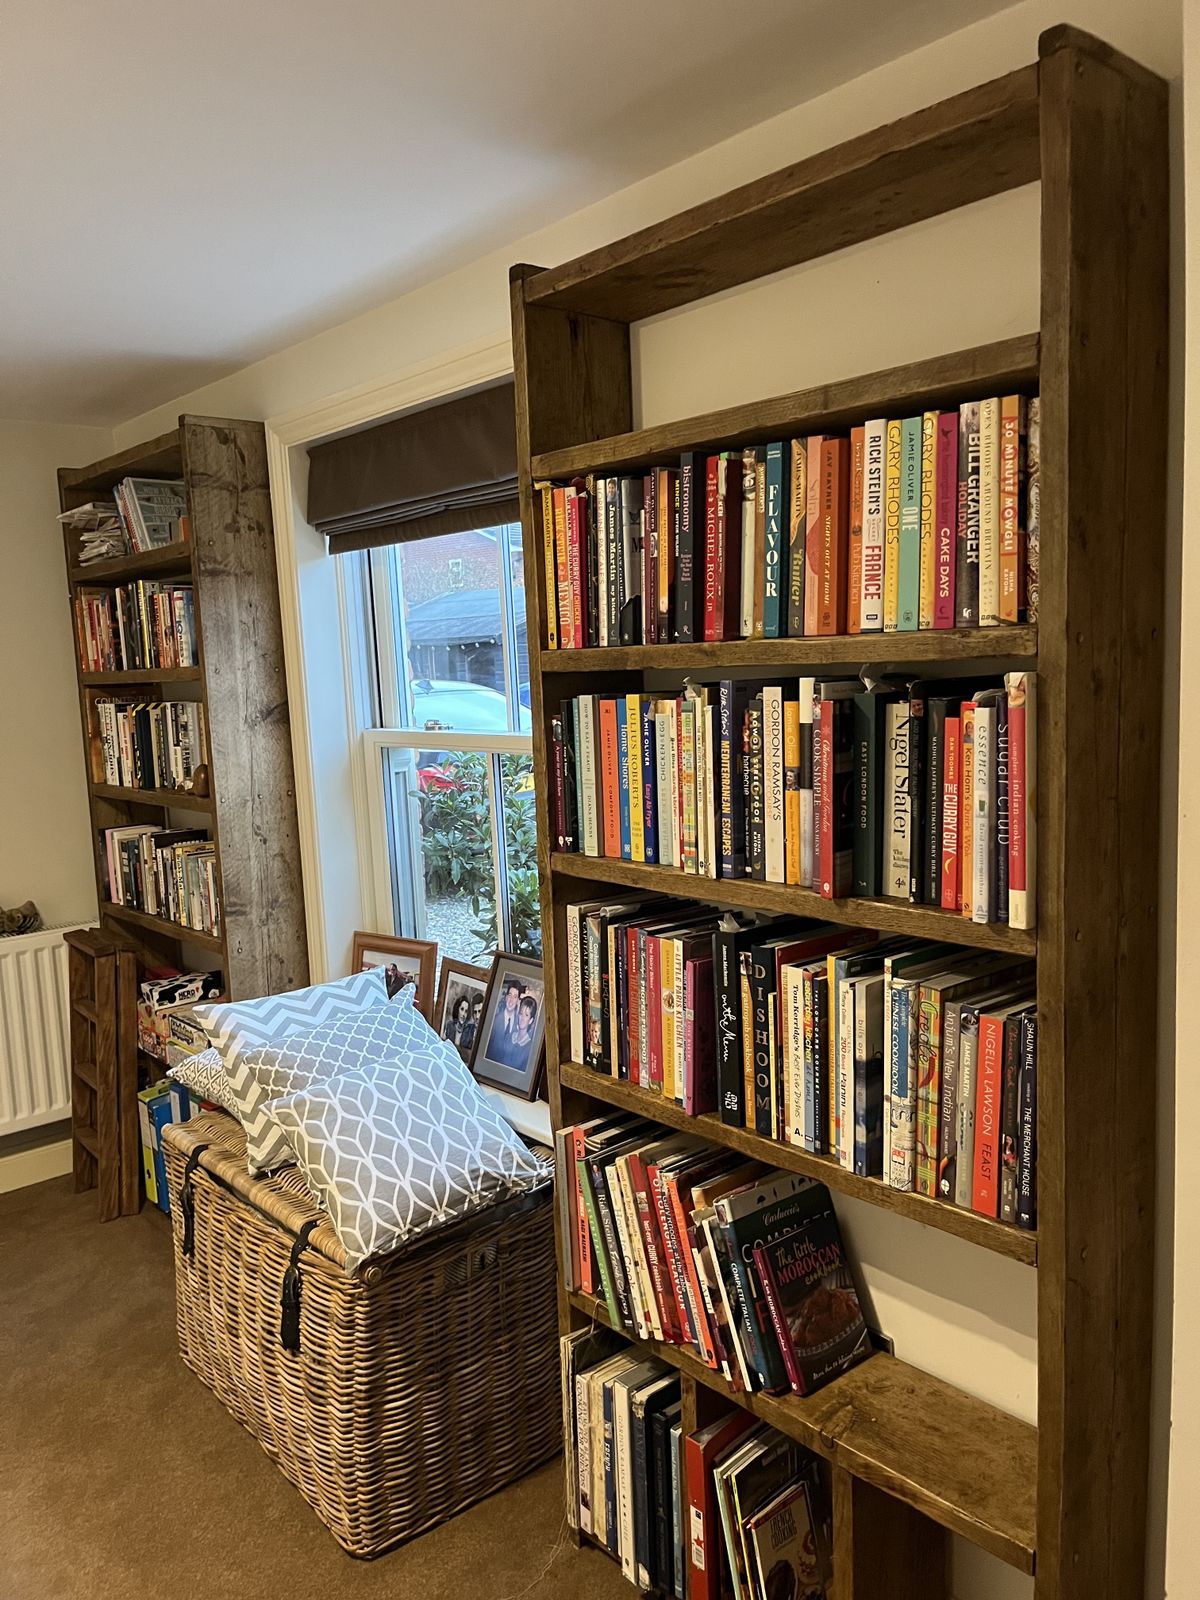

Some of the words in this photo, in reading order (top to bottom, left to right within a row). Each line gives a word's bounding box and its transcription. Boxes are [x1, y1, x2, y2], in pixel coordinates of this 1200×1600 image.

[984, 402, 992, 430] OPEN
[1005, 421, 1014, 438] 30
[868, 435, 882, 464] RICK
[888, 426, 900, 476] GARY
[907, 431, 915, 462] JAMIE
[921, 418, 934, 463] GARY
[968, 432, 980, 472] BILL
[984, 434, 992, 477] RHODES
[1004, 444, 1014, 492] MINUTE
[682, 465, 691, 533] bistronomy
[868, 468, 881, 515] STEIN'S
[920, 470, 933, 540] RHODES
[957, 480, 968, 538] HOLIDAY
[984, 482, 992, 523] AROUND
[887, 477, 900, 545] RHODES
[902, 506, 918, 531] ONE
[966, 475, 980, 564] GRANGER
[1004, 497, 1014, 551] MOWGLI
[706, 507, 715, 560] MICHEL
[765, 484, 779, 597] FLAVOUR
[940, 527, 950, 563] CAKE
[984, 528, 993, 571] BRITAIN
[572, 557, 580, 580] CURRY
[609, 542, 617, 581] Martin
[864, 545, 882, 601] FRANCE
[610, 585, 615, 596] my
[706, 564, 715, 600] ROUX
[939, 566, 950, 598] DAYS
[547, 580, 555, 628] COMFORTS
[558, 581, 570, 625] MEXICO
[707, 602, 712, 612] JR
[629, 706, 638, 750] JULIUS
[771, 699, 780, 758] GORDON
[786, 706, 794, 732] Jamie
[620, 724, 629, 752] Home
[786, 735, 796, 764] Oliver
[813, 729, 822, 763] COOK
[889, 713, 909, 771] Nigel
[977, 725, 988, 786] essence
[621, 757, 629, 789] Shores
[742, 755, 750, 795] barbecue
[752, 758, 760, 792] STREET
[965, 747, 973, 767] Ken
[1011, 742, 1019, 775] complete
[631, 753, 639, 809] ROBERTS
[644, 783, 652, 800] Easy
[720, 740, 731, 814] MEDITERRANEAN
[771, 762, 781, 821] RAMSAY'S
[813, 766, 822, 807] SIMPLE
[964, 769, 973, 801] Hom's
[893, 775, 909, 839] Slater
[942, 794, 957, 830] CURRY
[1012, 779, 1021, 815] indian
[645, 809, 653, 829] Fryer
[963, 802, 973, 832] Quick
[721, 817, 732, 856] ESCAPES
[942, 831, 957, 855] GUY
[964, 833, 972, 857] Wok
[1011, 819, 1020, 857] cooking
[572, 916, 580, 964] GORDON
[178, 990, 196, 998] HERD
[573, 966, 581, 1014] RAMSAY'S
[675, 984, 683, 1008] PARIS
[803, 980, 813, 1025] saturday
[741, 993, 750, 1033] gastropub
[792, 1005, 801, 1052] Kerridge's
[753, 964, 770, 1111] DISHOOM
[804, 1026, 813, 1063] kitchen
[918, 1000, 939, 1065] Creole
[944, 1010, 957, 1054] Anjum's
[984, 1023, 997, 1075] NIGELLA
[1026, 1022, 1035, 1052] SHAUN
[744, 1034, 752, 1073] cookbook
[793, 1053, 801, 1072] Best
[945, 1059, 956, 1081] New
[962, 1040, 971, 1067] JAMES
[1025, 1053, 1034, 1071] HILL
[840, 1072, 848, 1108] Panini
[962, 1067, 971, 1097] MARTIN
[794, 1091, 802, 1119] Dishes
[943, 1083, 955, 1122] Indian
[982, 1079, 995, 1137] LAWSON
[1024, 1107, 1032, 1122] THE
[980, 1143, 992, 1180] FEAST
[1022, 1123, 1031, 1168] MERCHANT
[617, 1164, 626, 1182] good
[621, 1183, 631, 1199] food
[1021, 1168, 1030, 1197] HOUSE
[598, 1194, 609, 1217] Rick
[662, 1196, 671, 1217] Gary
[603, 1218, 616, 1249] Stein's
[628, 1212, 638, 1237] friends
[643, 1220, 652, 1243] best-ever
[665, 1218, 678, 1249] Rhodes
[586, 1201, 601, 1251] ESSENTIAL
[599, 1263, 612, 1304] COOKING
[647, 1244, 658, 1265] CURRY
[652, 1178, 672, 1252] OTTOLENGHI
[670, 1258, 685, 1310] FLAVOUR
[674, 1252, 679, 1260] at
[776, 1247, 794, 1267] The
[794, 1235, 816, 1260] little
[609, 1251, 620, 1279] French
[652, 1265, 663, 1292] cookbook
[778, 1242, 840, 1286] MOROCCAN
[677, 1275, 687, 1293] table
[729, 1262, 746, 1302] COMPLETE
[739, 1302, 753, 1333] ITALIAN
[767, 1295, 782, 1333] MOROCCAN
[576, 1380, 584, 1423] COOKING
[578, 1448, 586, 1488] FRIENDS
